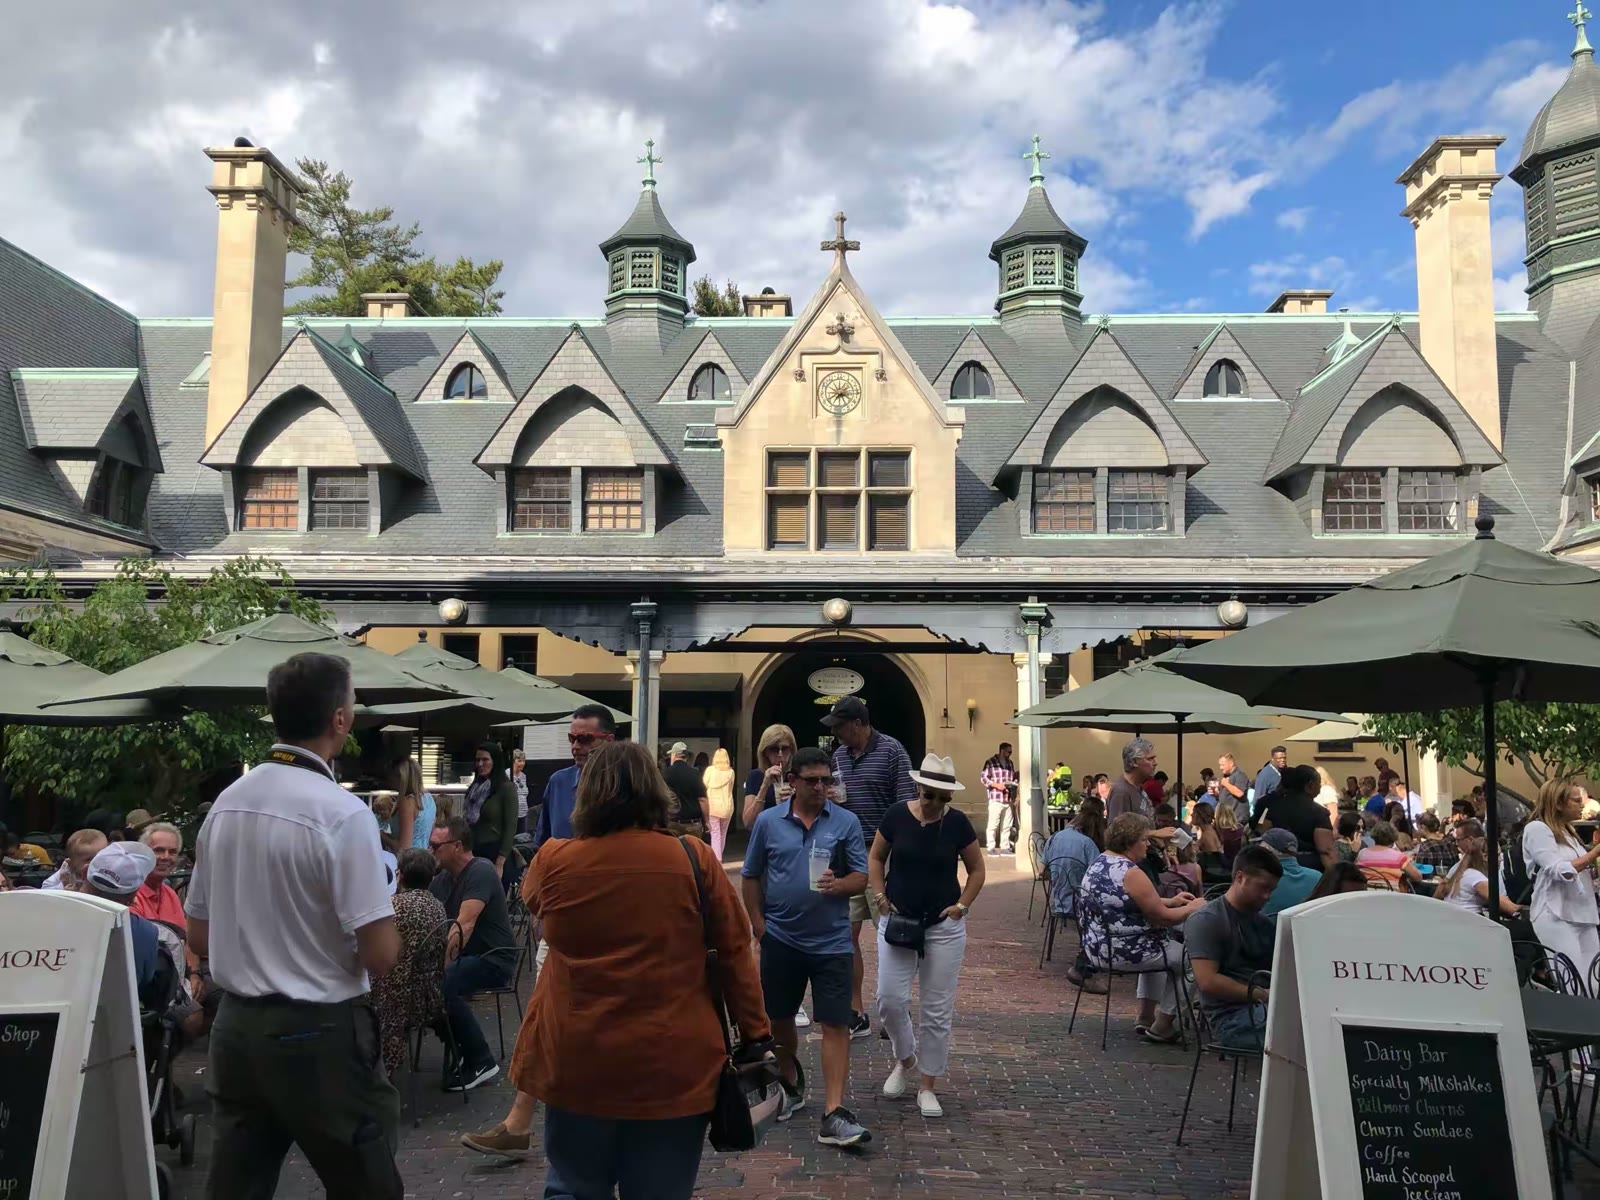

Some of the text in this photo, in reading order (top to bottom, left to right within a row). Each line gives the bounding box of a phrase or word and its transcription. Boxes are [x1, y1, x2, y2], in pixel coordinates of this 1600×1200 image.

[1331, 960, 1489, 990] BILTMORE
[2, 1024, 40, 1051] Shop
[1364, 1040, 1448, 1070] Dairy Bar
[1416, 1099, 1465, 1116] Churns
[1360, 1120, 1473, 1140] Churn Sundaes
[1364, 1144, 1410, 1165] Coffee
[1365, 1165, 1456, 1191] Hand Scooped
